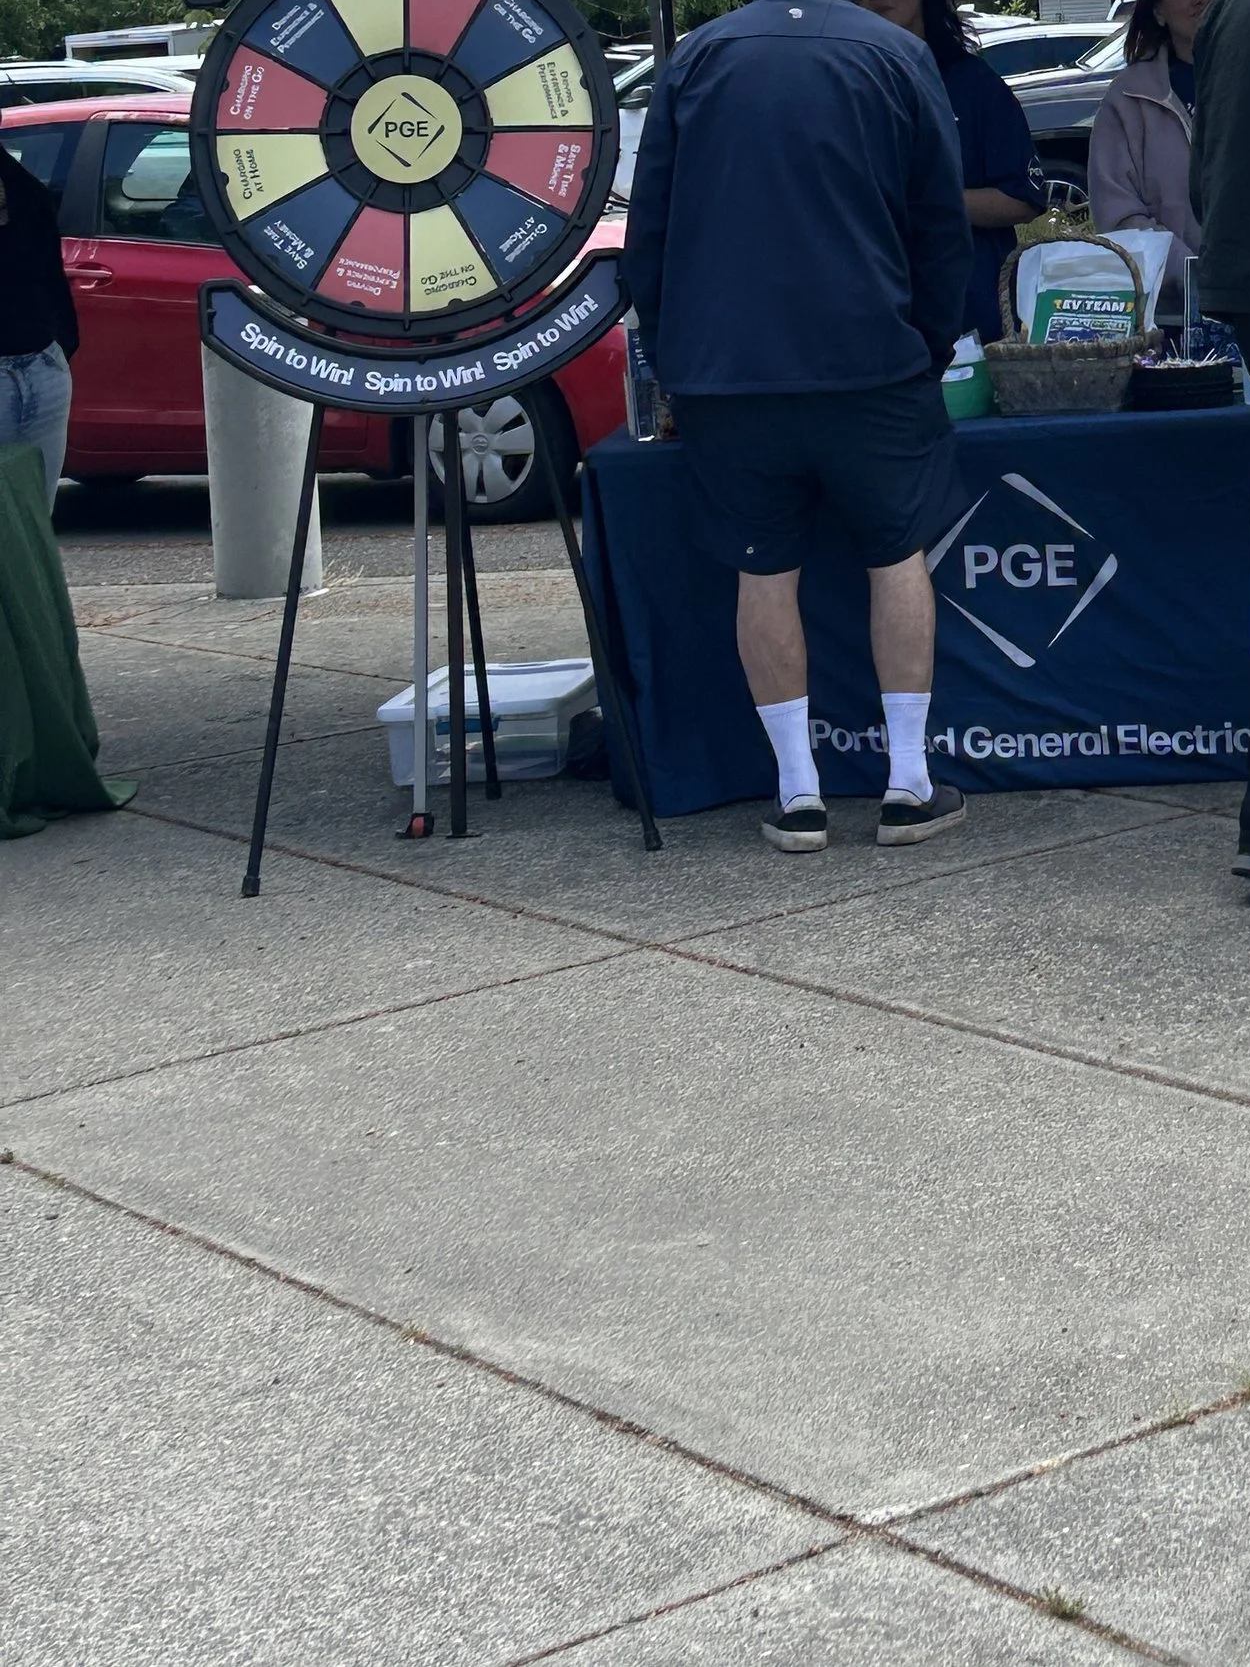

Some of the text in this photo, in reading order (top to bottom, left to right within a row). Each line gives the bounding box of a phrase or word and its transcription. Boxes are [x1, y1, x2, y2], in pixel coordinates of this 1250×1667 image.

[384, 120, 430, 139] PGE
[240, 293, 599, 395] Spin to Win! Spin to Win! Spin to Win!
[963, 543, 1079, 589] PGE
[963, 724, 1109, 760] General
